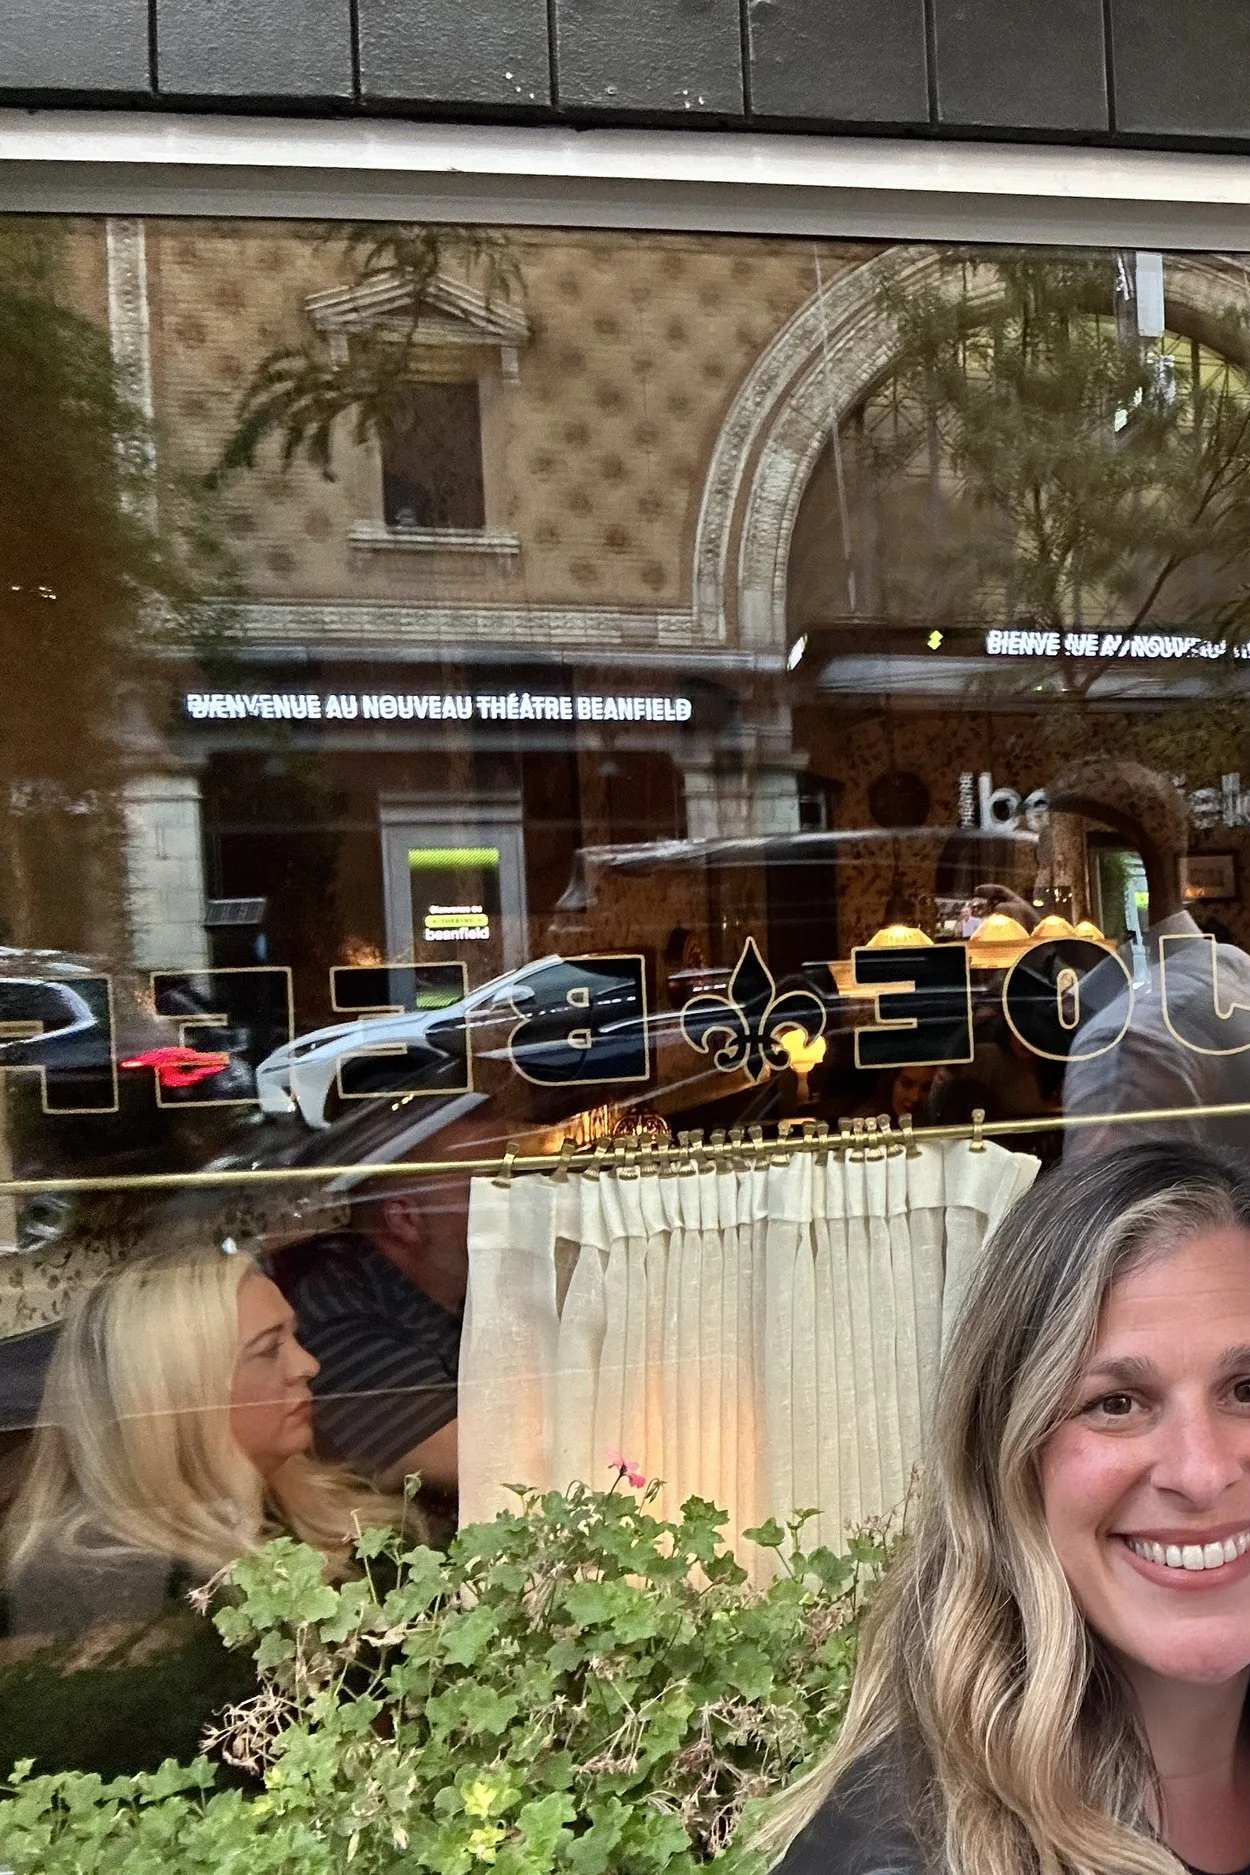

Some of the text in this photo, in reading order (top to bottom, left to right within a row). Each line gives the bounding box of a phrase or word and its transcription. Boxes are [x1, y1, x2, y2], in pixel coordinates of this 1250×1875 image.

[187, 692, 692, 721] BIENVENUE AU NOUVEAU THÉÂTRE BEANFIELD
[424, 926, 490, 941] beanfield
